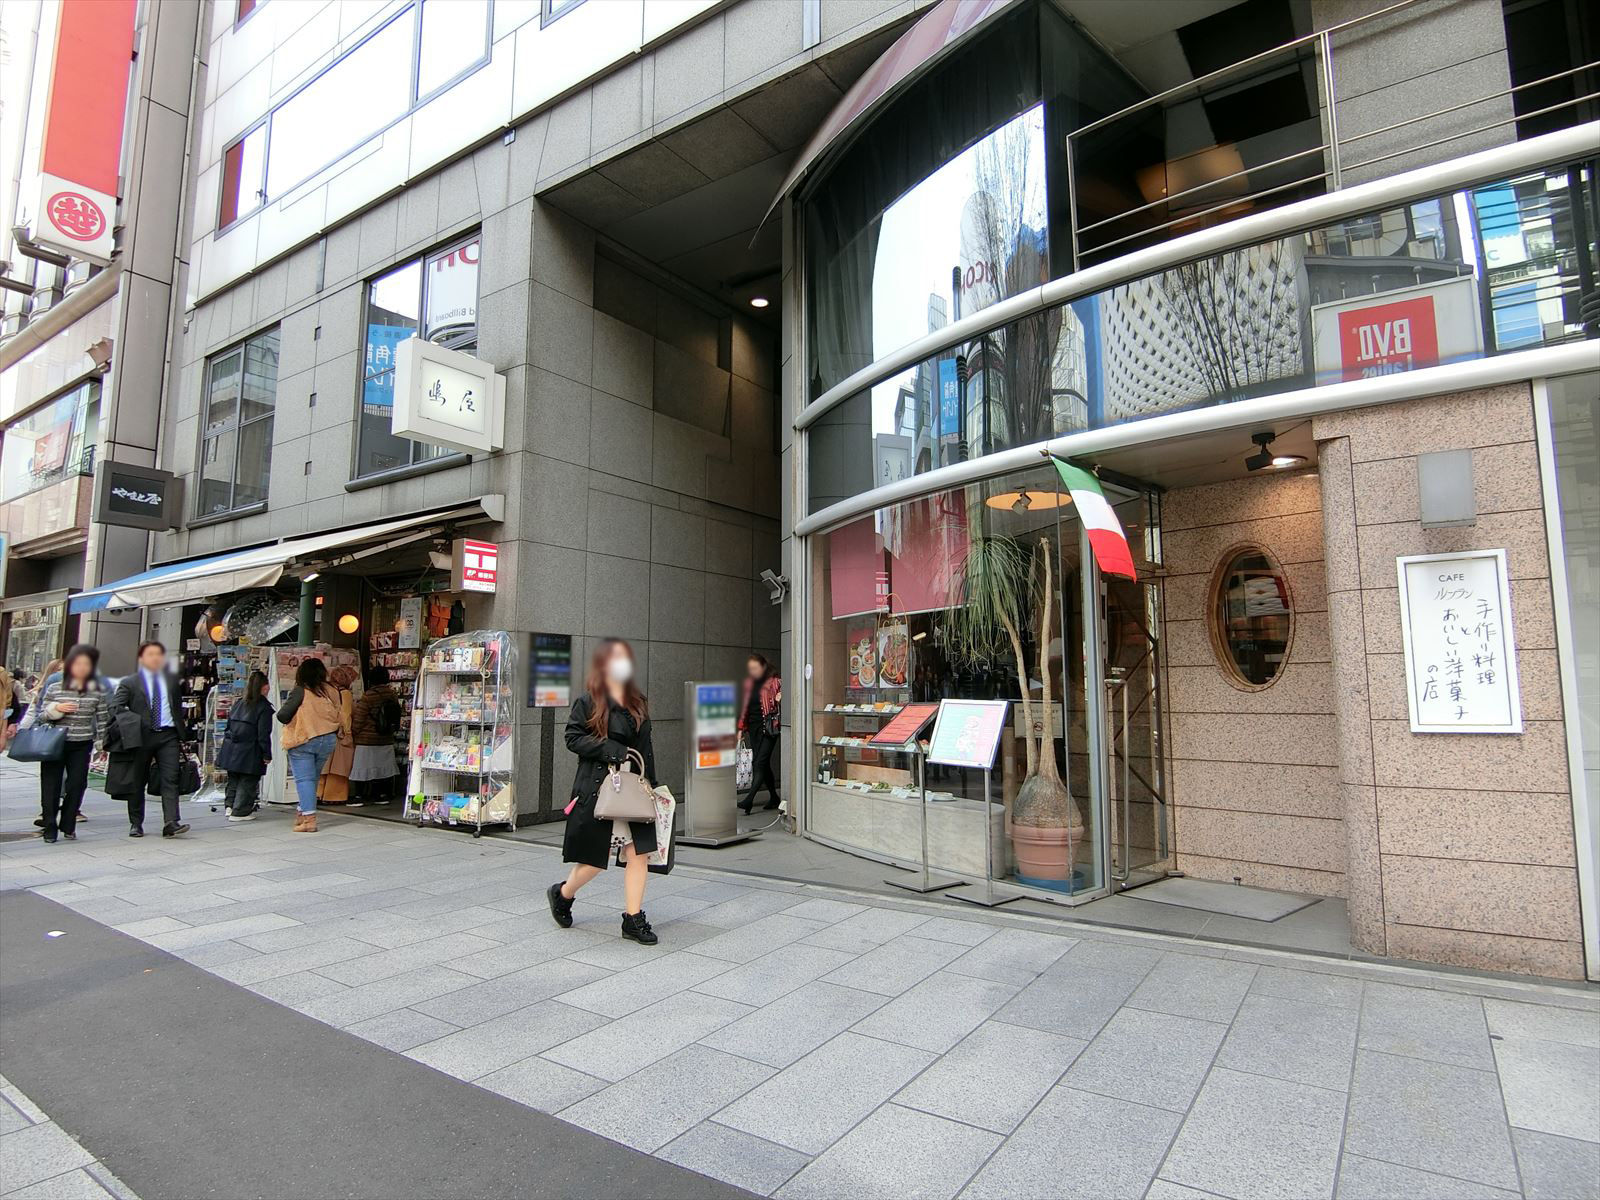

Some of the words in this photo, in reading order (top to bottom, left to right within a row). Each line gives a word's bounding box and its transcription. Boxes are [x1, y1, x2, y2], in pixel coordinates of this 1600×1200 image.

[1438, 573, 1465, 583] CAFE
[1443, 608, 1469, 721] おいしい洋菓子
[1471, 598, 1497, 685] 手作り料理
[1422, 664, 1439, 702] の店
